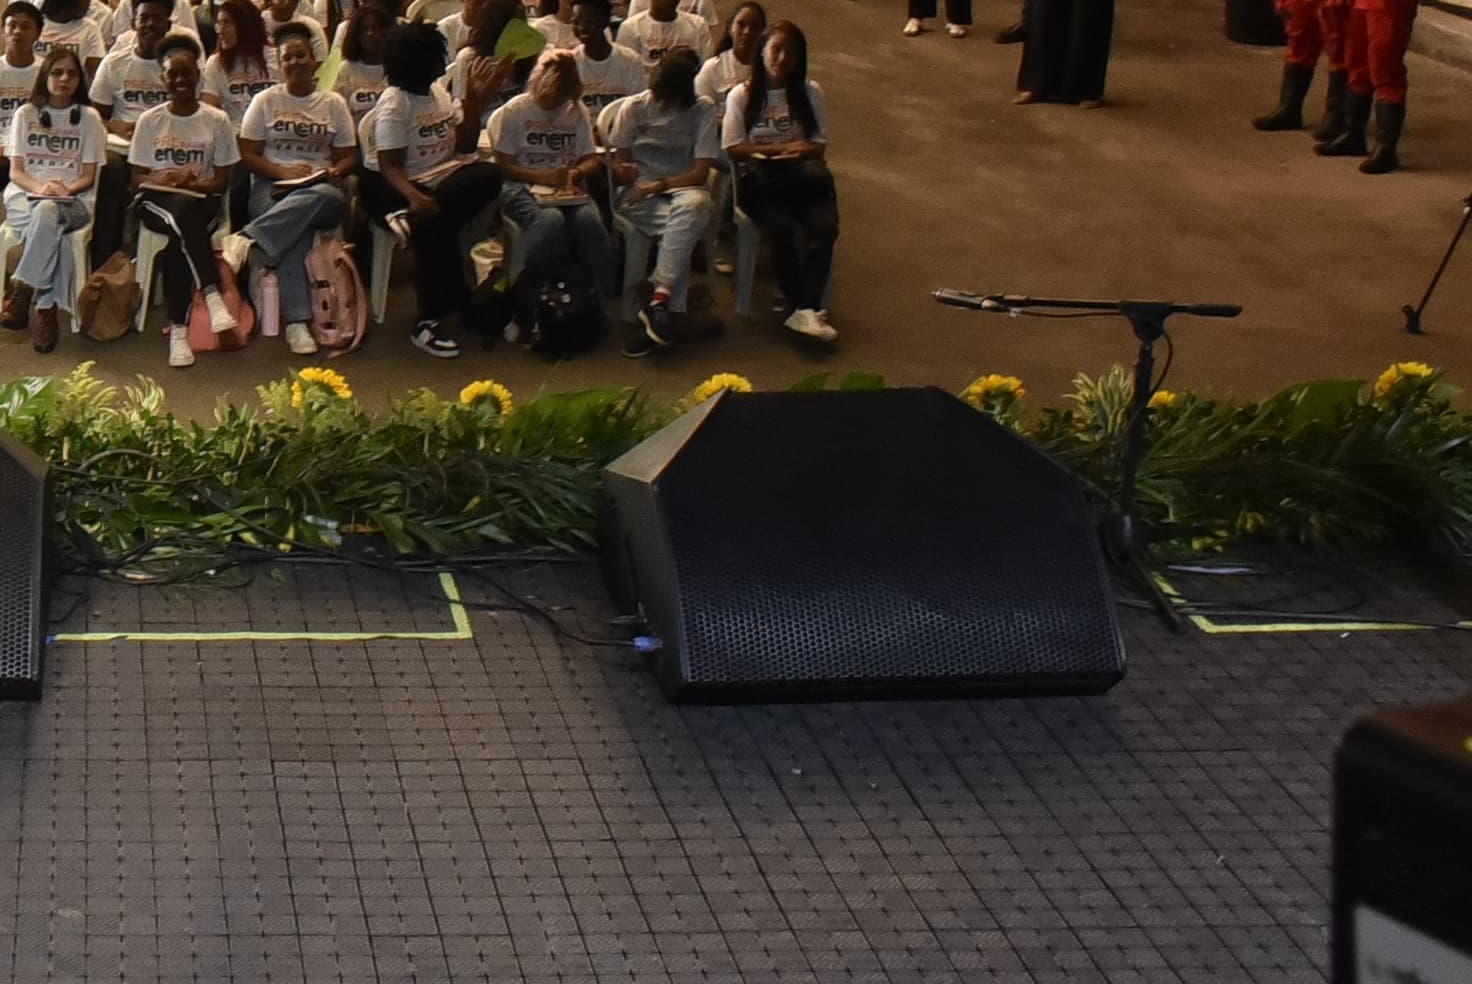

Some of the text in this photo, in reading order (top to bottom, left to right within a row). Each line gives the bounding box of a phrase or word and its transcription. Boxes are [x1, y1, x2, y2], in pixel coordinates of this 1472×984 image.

[274, 120, 327, 137] enem
[28, 133, 80, 152] enem
[154, 148, 204, 165] enem
